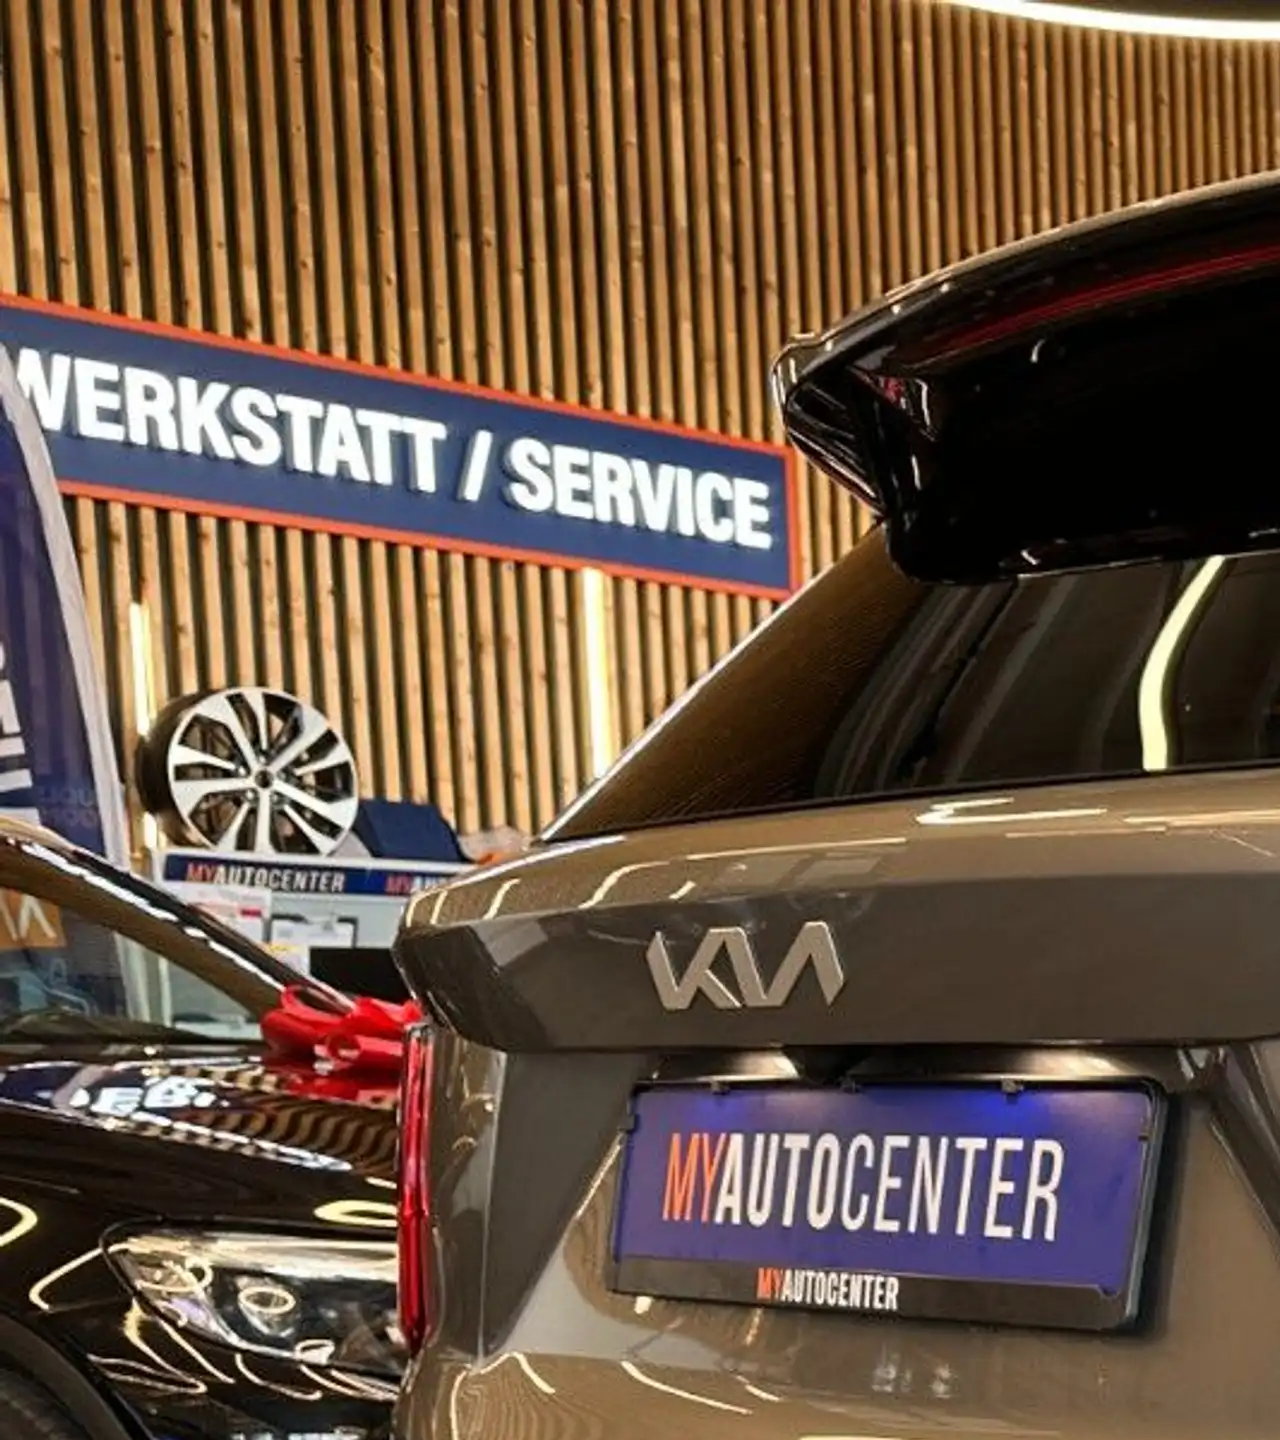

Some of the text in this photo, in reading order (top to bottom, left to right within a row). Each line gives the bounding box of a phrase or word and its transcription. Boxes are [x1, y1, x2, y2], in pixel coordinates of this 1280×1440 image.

[16, 346, 773, 550] WERKSTATT / SERVICE
[186, 862, 346, 894] MYAUTOCENTER
[661, 1131, 1065, 1242] MYAUTOCENTER
[756, 1265, 899, 1312] MYAUTOCENTER
